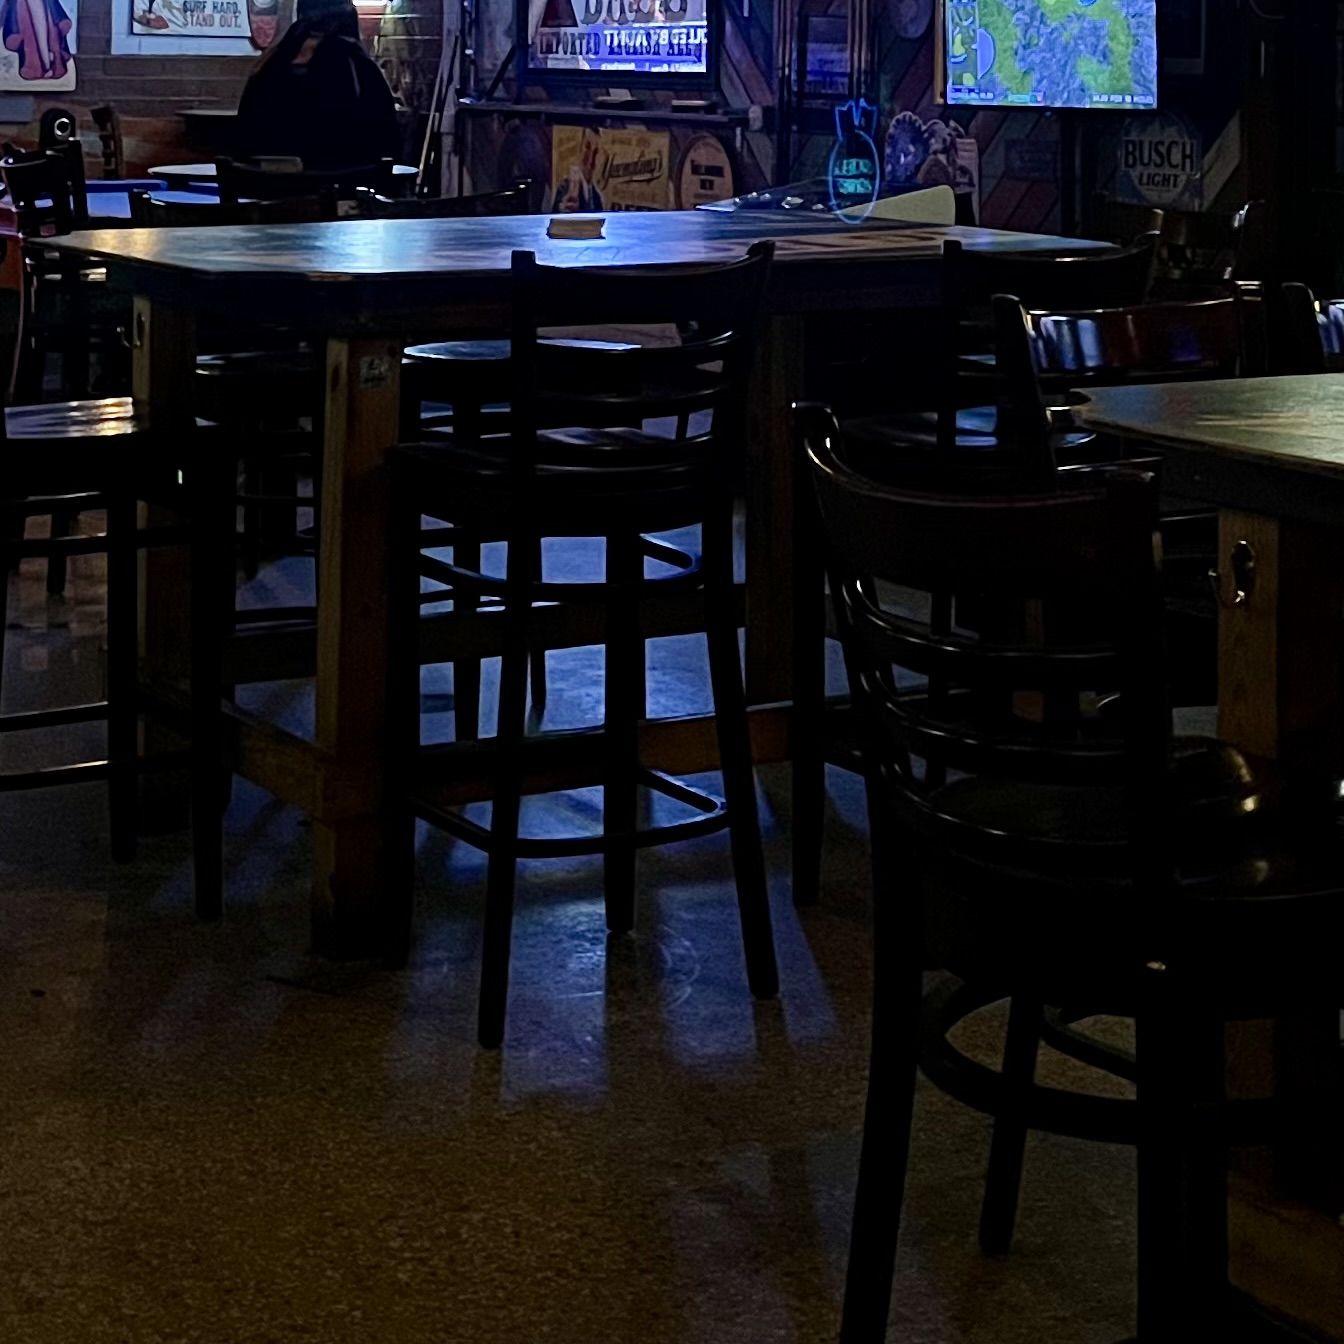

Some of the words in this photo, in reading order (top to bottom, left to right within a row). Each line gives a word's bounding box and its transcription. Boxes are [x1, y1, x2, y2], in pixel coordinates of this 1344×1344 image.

[182, 0, 207, 14] SURF
[182, 14, 214, 28] STAND
[219, 15, 241, 28] OUT.
[540, 32, 601, 55] IMPORTED
[1124, 140, 1194, 172] BUSCH
[1138, 171, 1179, 188] LIGHT
